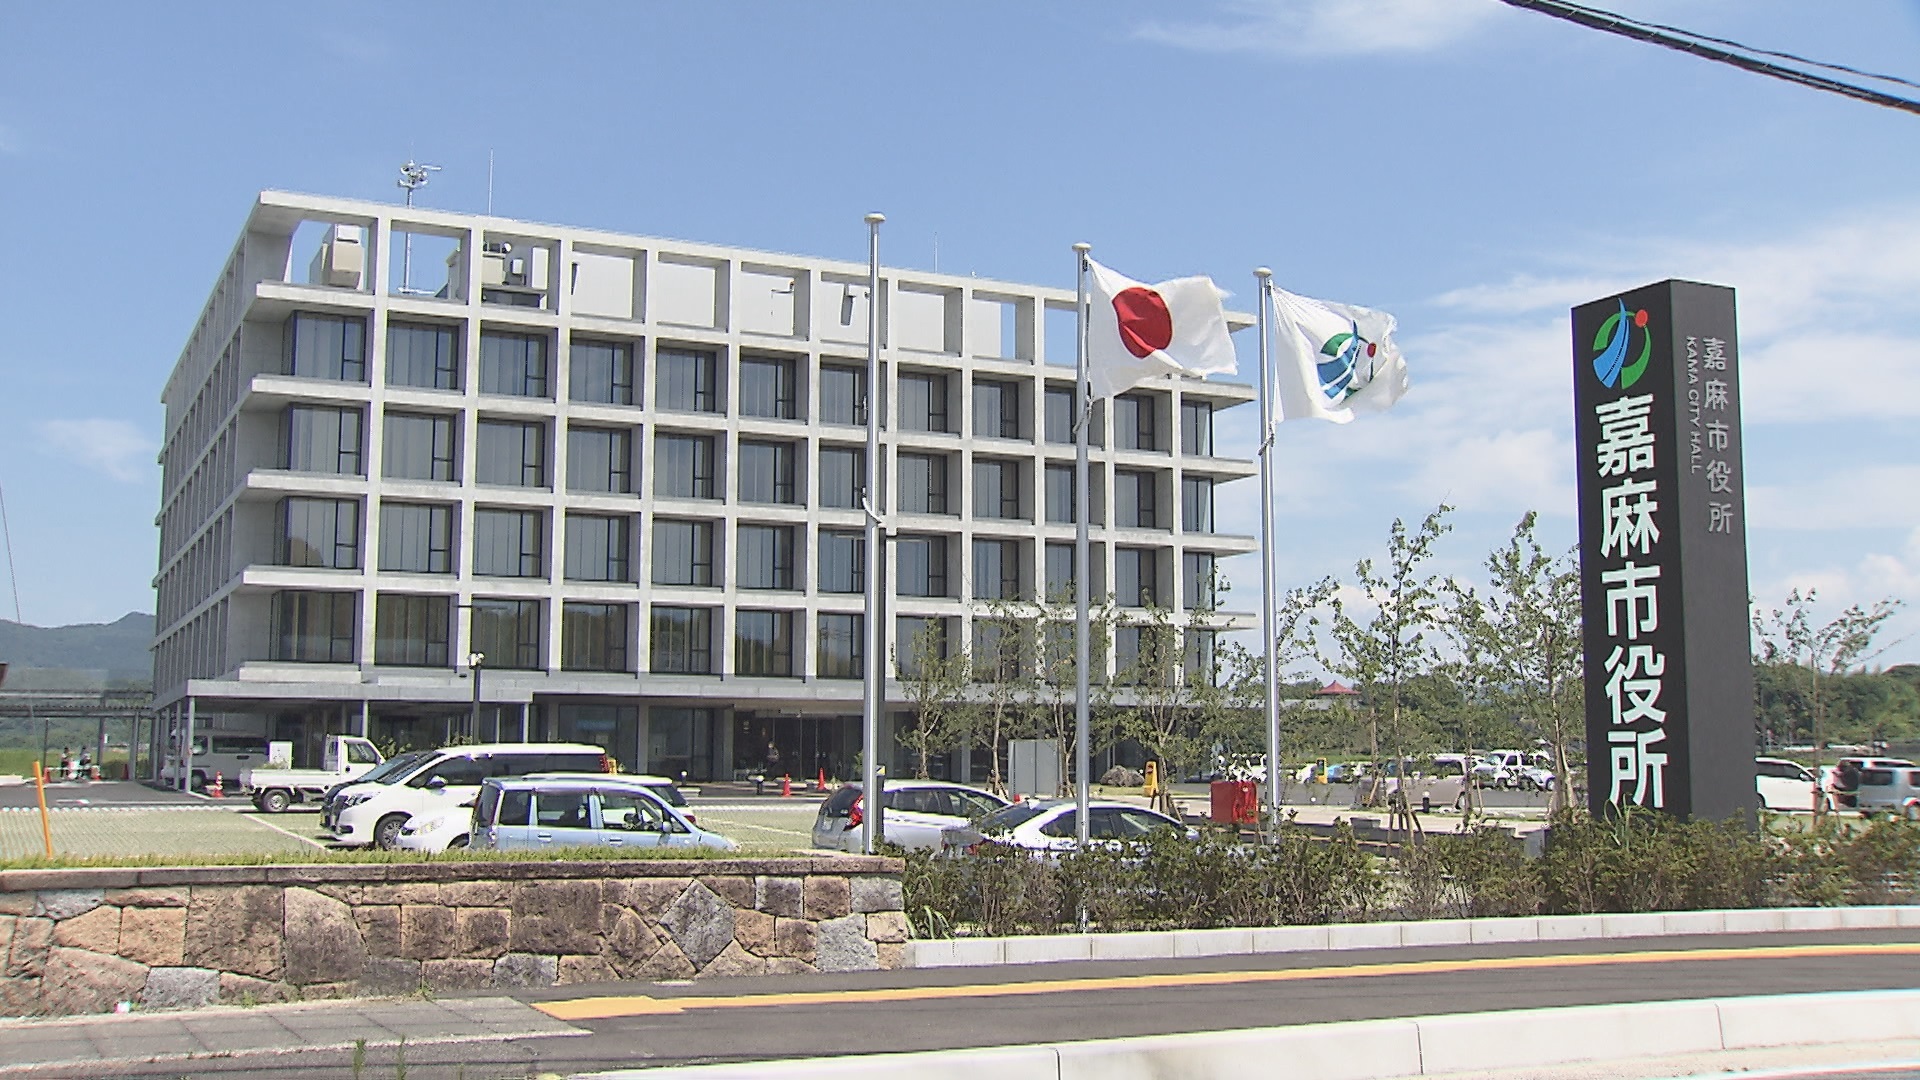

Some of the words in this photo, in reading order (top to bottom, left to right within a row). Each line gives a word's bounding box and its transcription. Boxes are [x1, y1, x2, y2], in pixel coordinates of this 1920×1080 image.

[1686, 336, 1699, 385] KAMA
[1688, 389, 1701, 429] CITY
[1690, 431, 1702, 474] HALL
[1703, 336, 1734, 534] 嘉麻市役所
[1596, 393, 1668, 809] 嘉麻市役所
